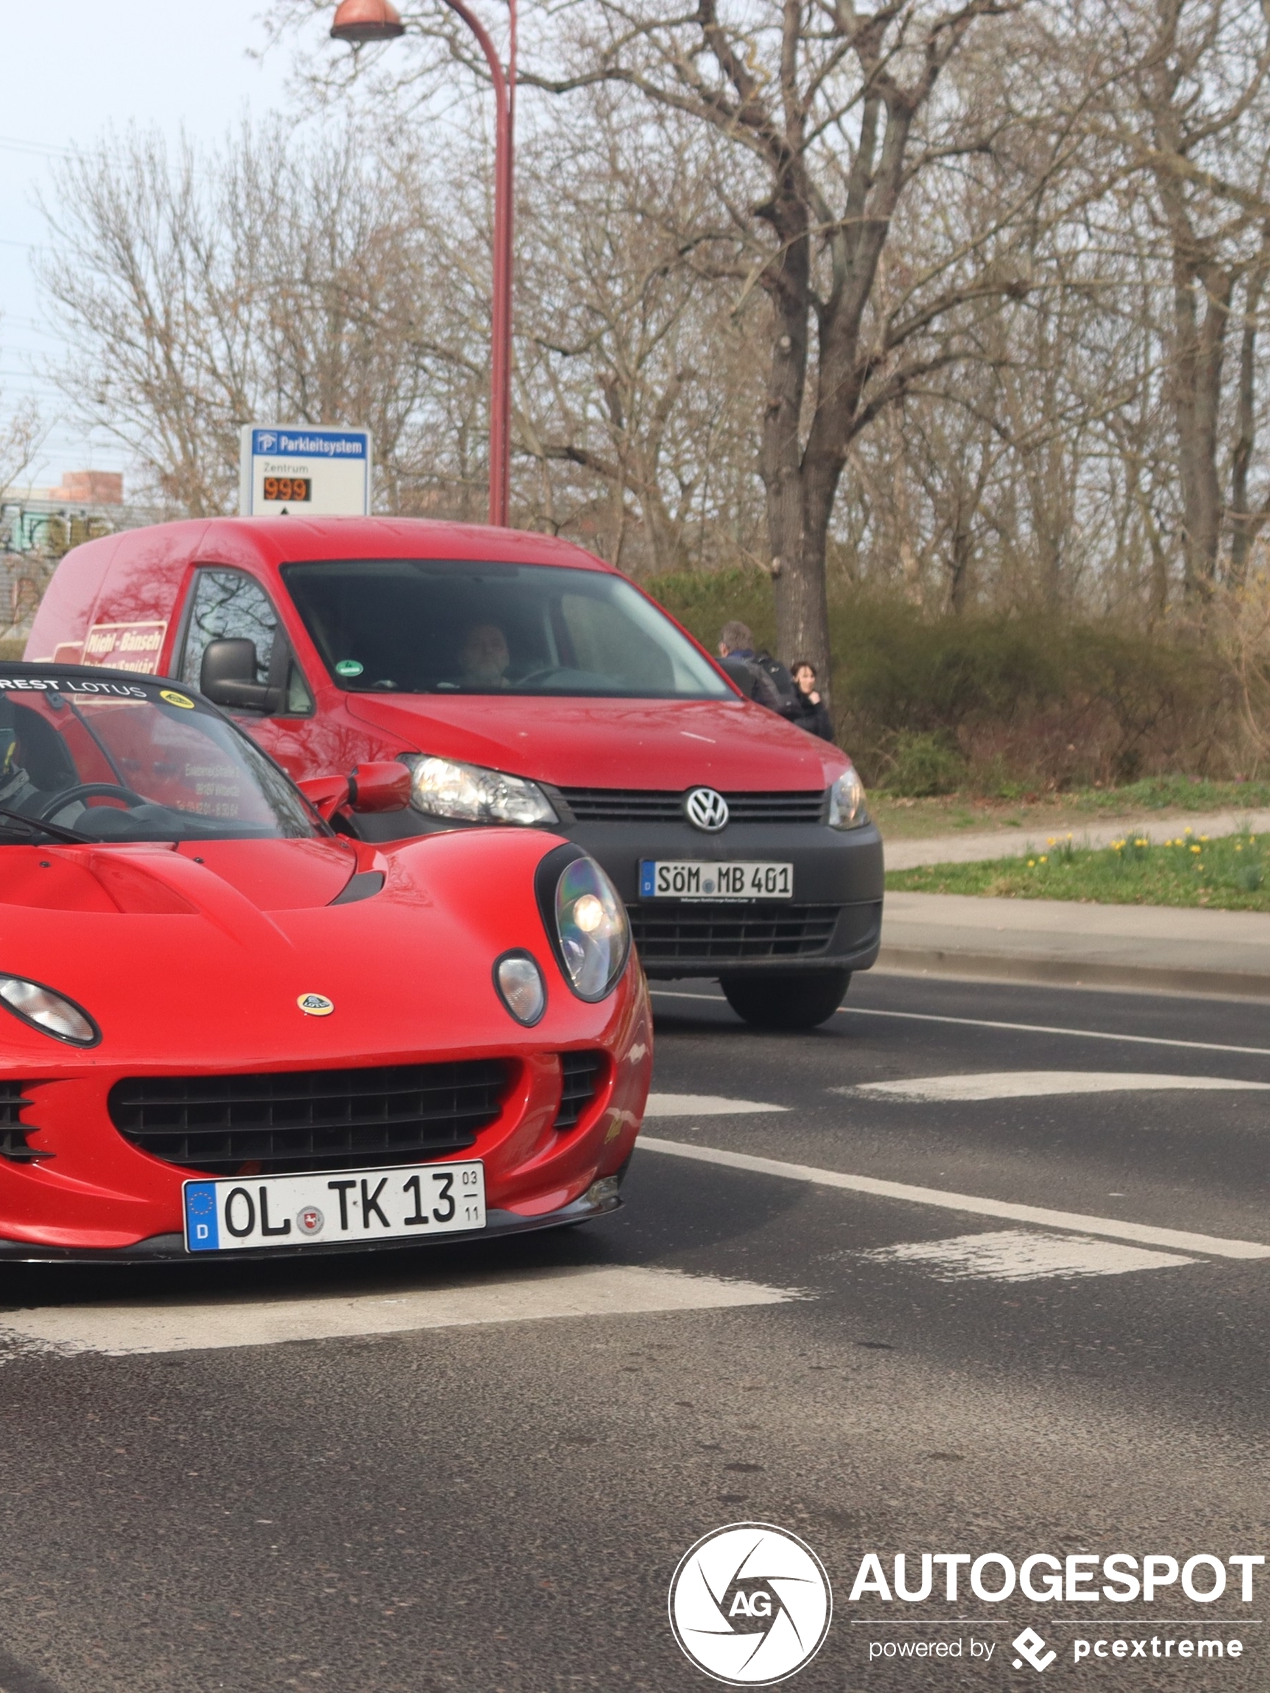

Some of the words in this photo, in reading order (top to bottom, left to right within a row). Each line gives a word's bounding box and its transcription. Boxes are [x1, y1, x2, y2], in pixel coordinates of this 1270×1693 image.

[281, 436, 362, 456] Parkleitsystem
[263, 462, 309, 474] Zentrum
[265, 477, 307, 500] 999
[120, 630, 161, 651] Bänsch
[66, 681, 148, 698] LOTUS
[644, 882, 651, 891] D
[657, 866, 700, 893] SÖM
[717, 867, 744, 893] MB
[751, 867, 790, 893] 401
[461, 1170, 478, 1186] 03
[196, 1223, 209, 1240] D
[224, 1186, 292, 1238] OL
[327, 1177, 391, 1231] TK
[402, 1172, 456, 1226] 13
[464, 1205, 479, 1221] 11
